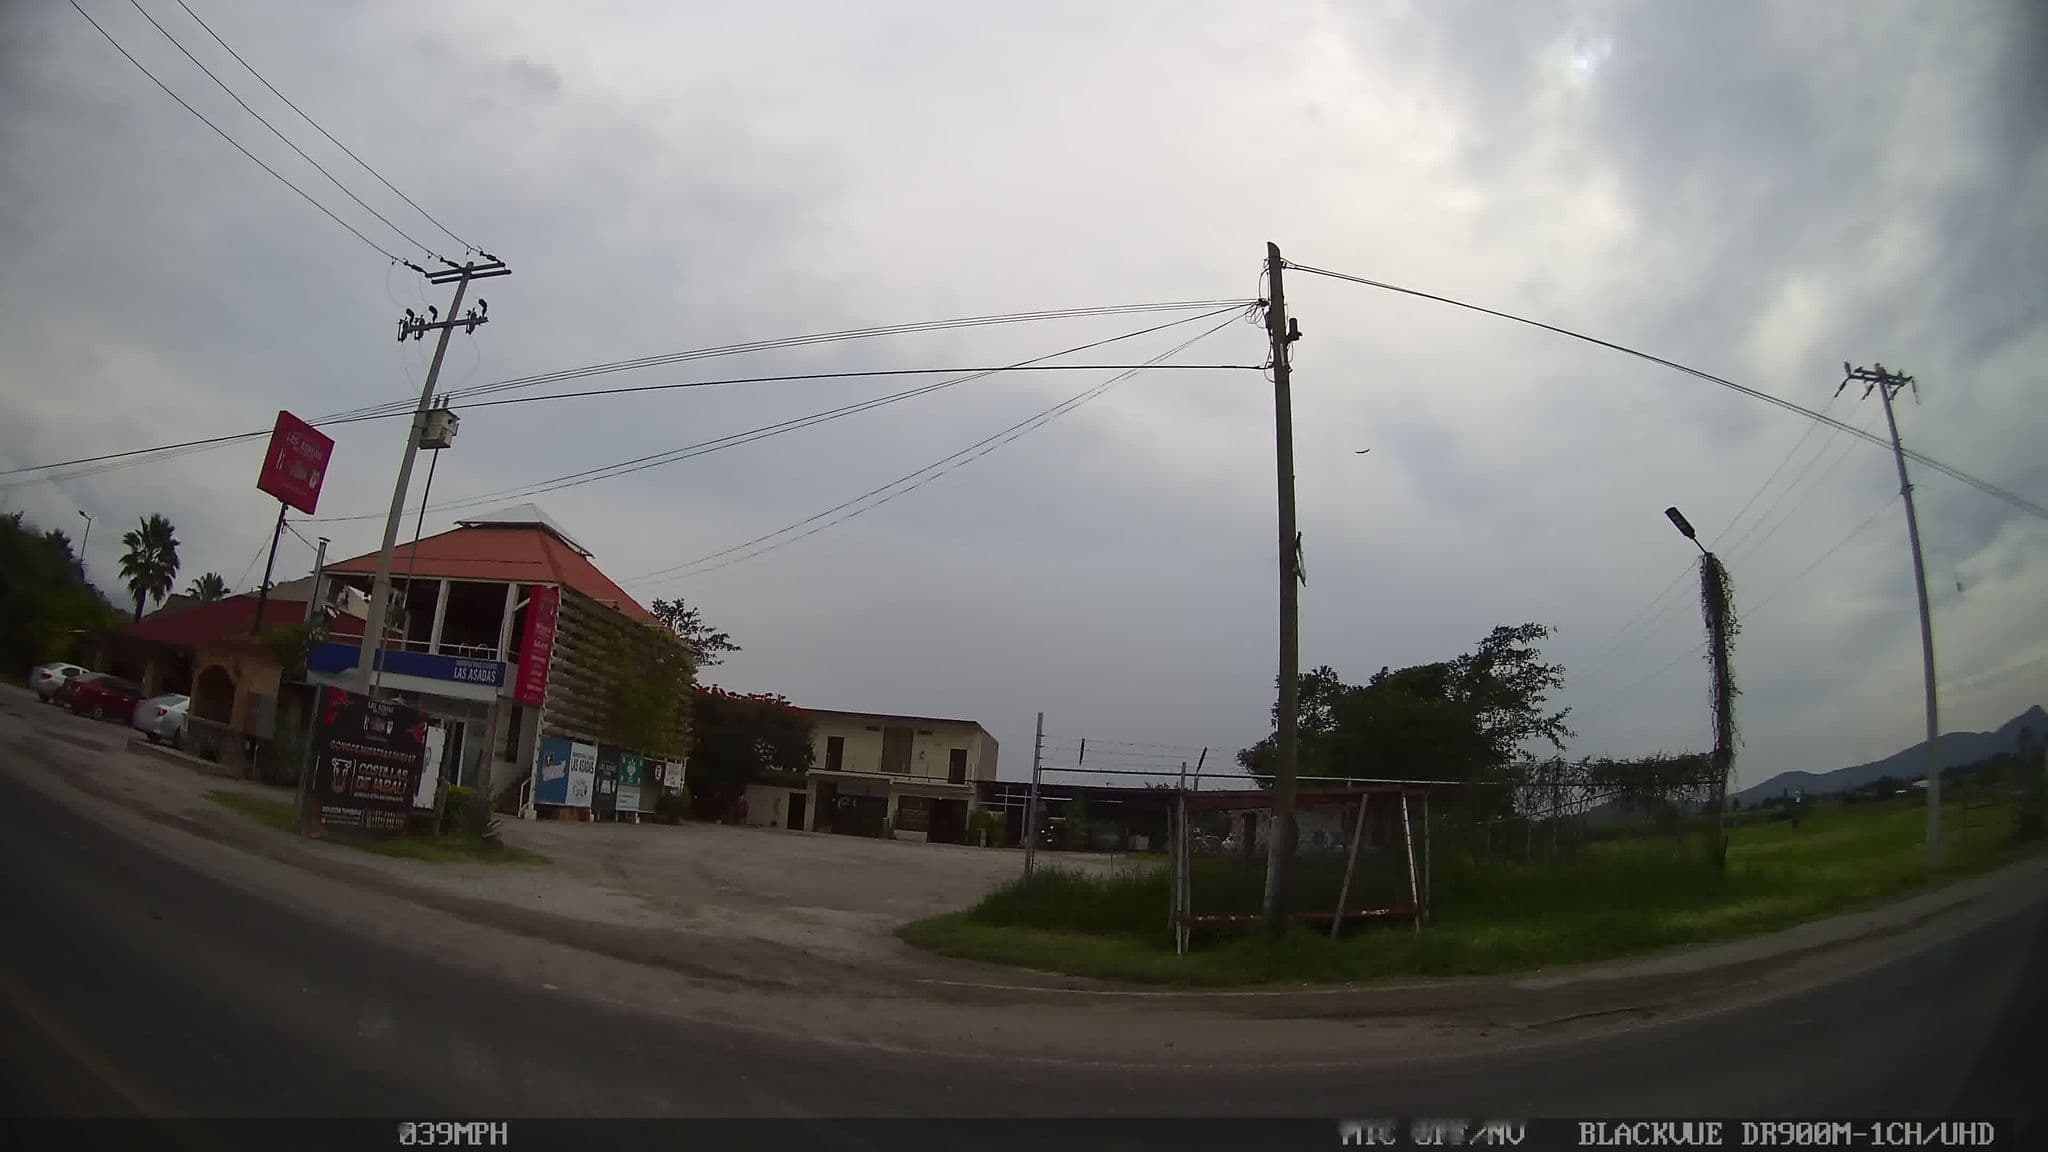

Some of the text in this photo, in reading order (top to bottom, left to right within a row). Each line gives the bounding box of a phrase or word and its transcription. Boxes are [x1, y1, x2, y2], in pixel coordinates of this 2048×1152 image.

[454, 666, 497, 683] LAS ASADAS
[358, 762, 409, 779] COSTILLAS
